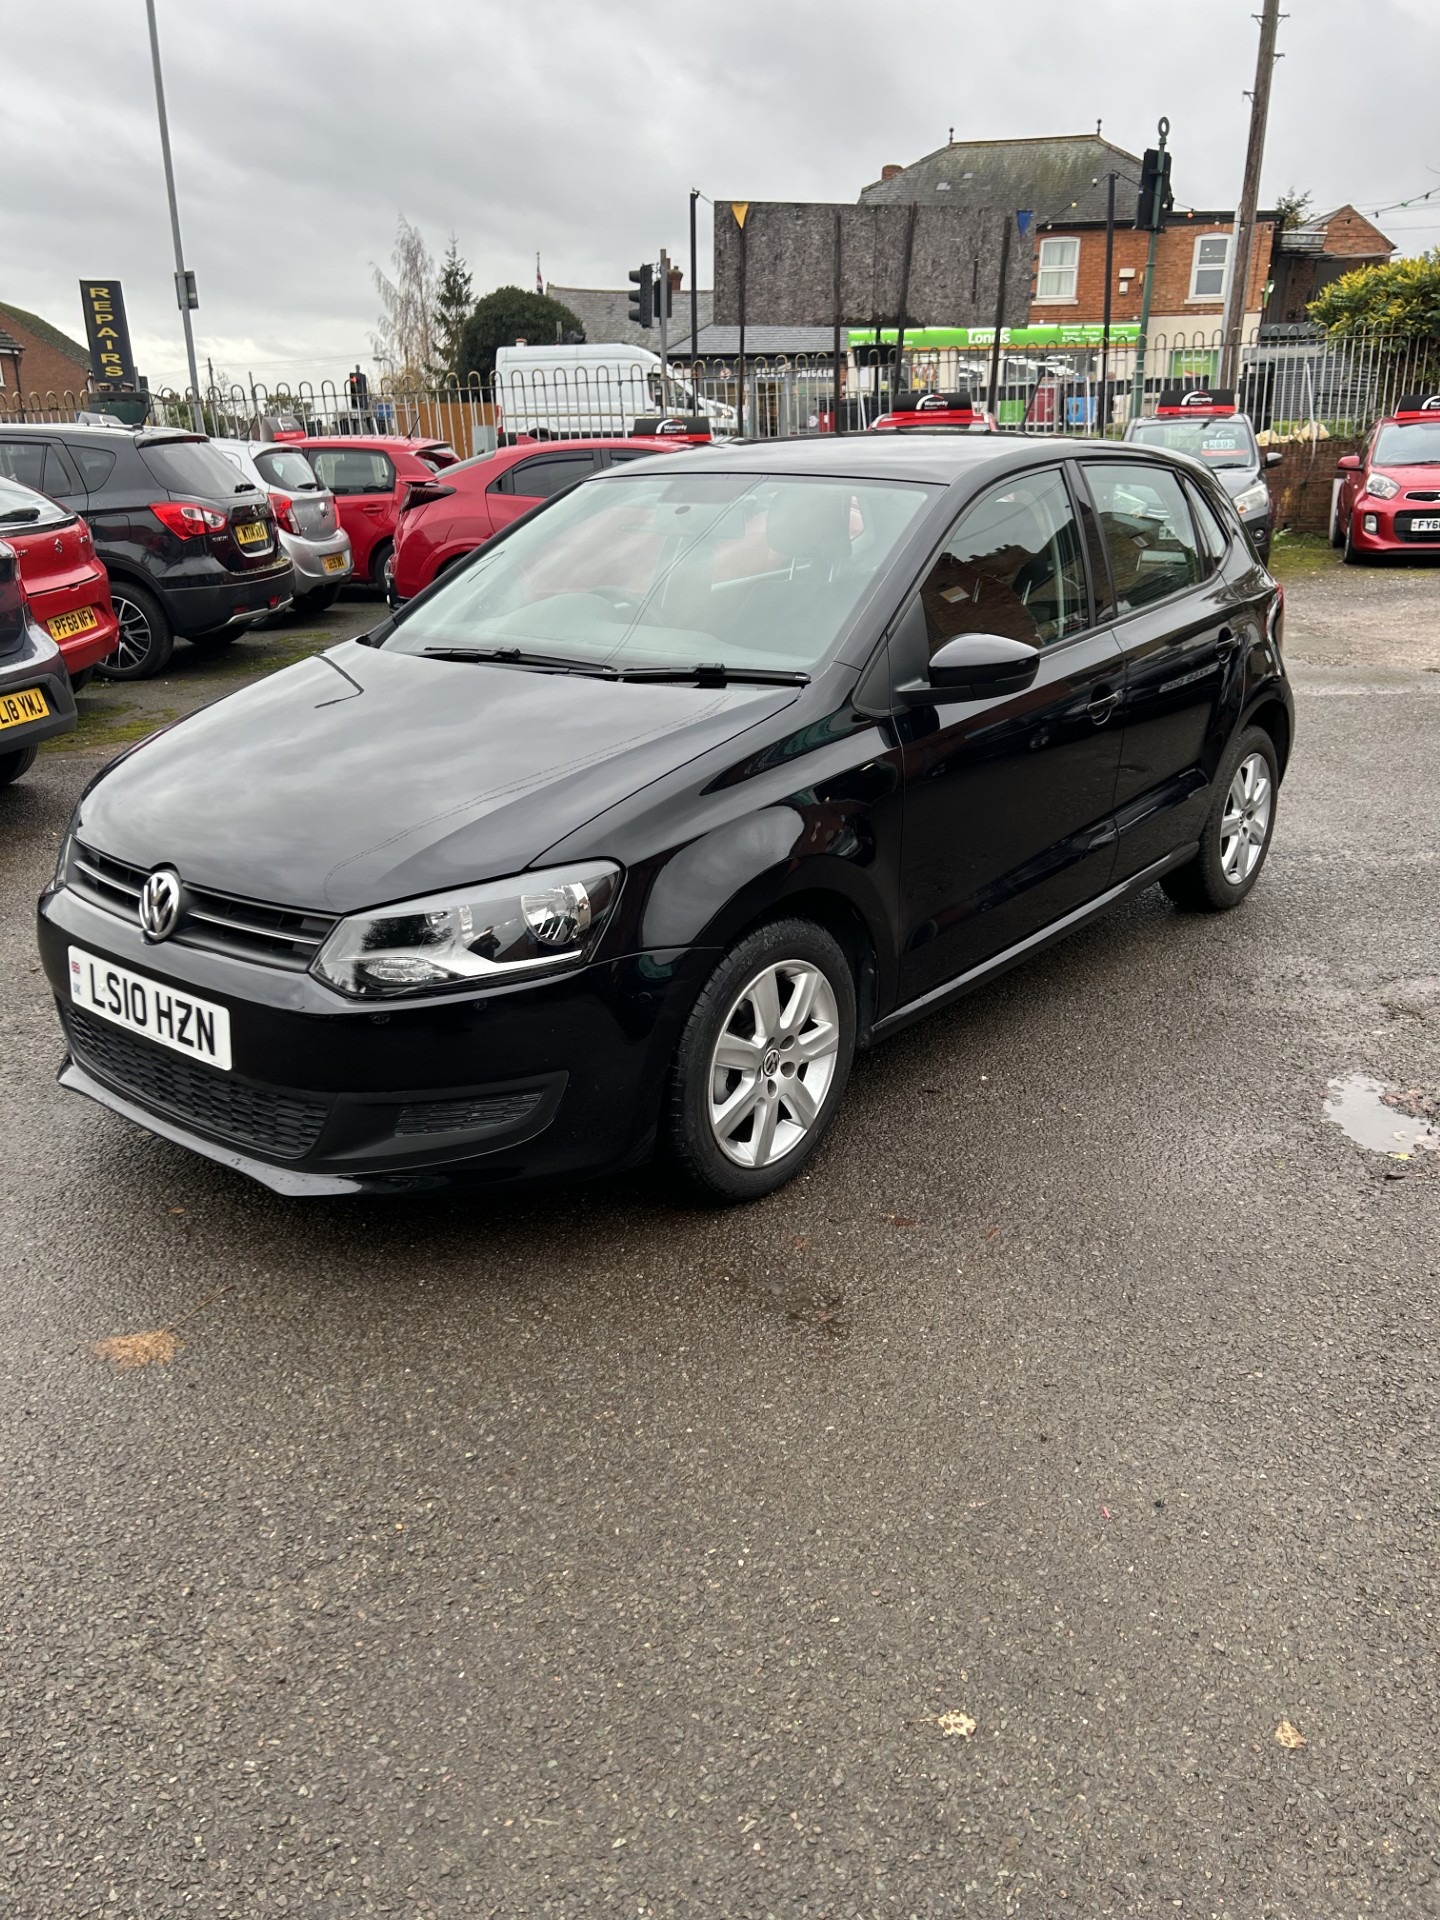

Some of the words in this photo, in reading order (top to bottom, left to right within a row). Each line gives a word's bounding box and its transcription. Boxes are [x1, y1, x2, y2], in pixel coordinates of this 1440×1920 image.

[89, 287, 124, 377] REPAIRS
[1417, 520, 1440, 529] FY6
[54, 615, 80, 636] PF68
[0, 699, 20, 724] L18
[17, 691, 43, 718] YMJ
[89, 963, 147, 1027] LS10
[155, 991, 215, 1056] HZN
